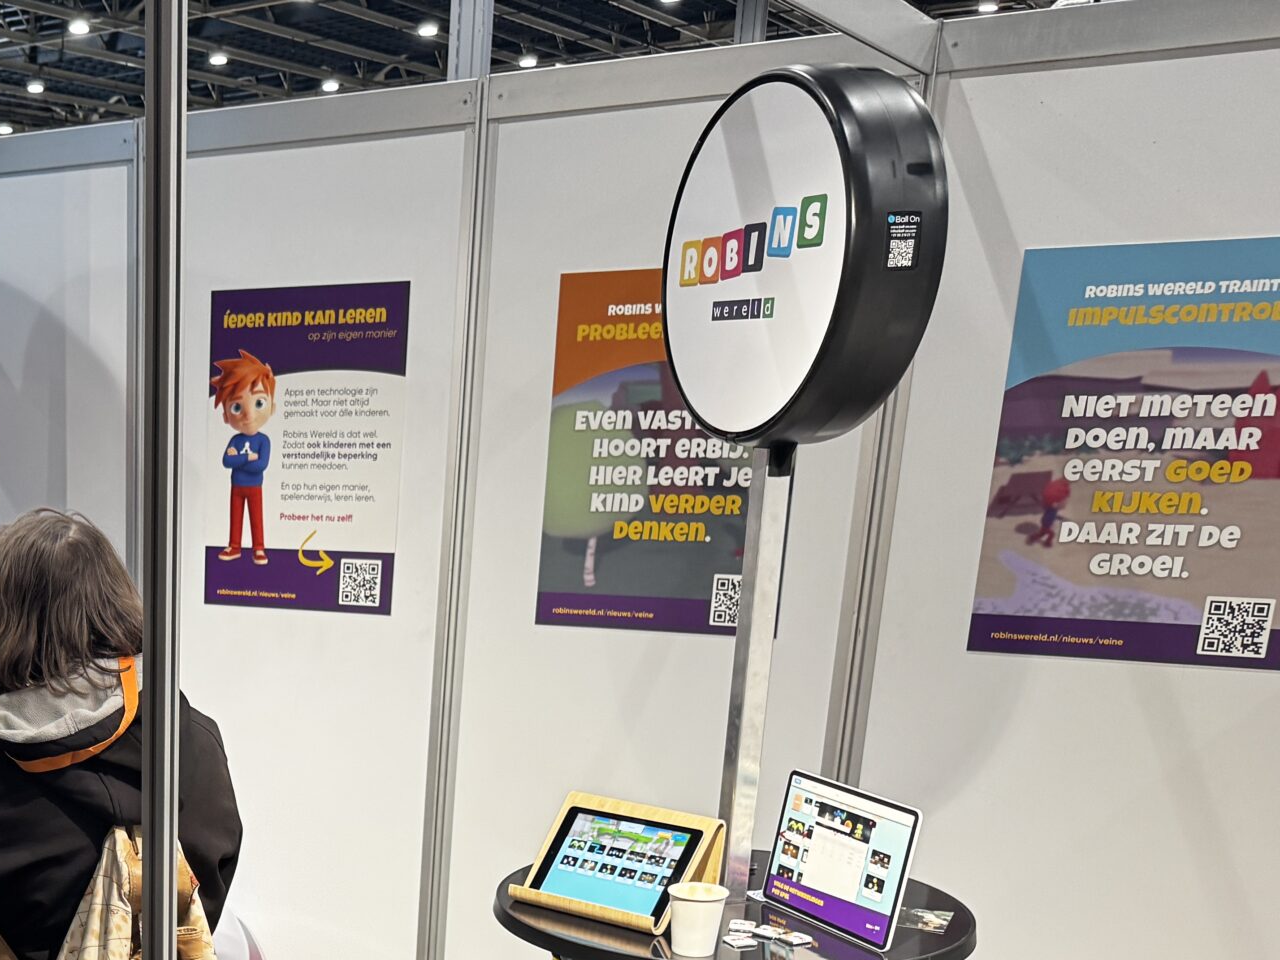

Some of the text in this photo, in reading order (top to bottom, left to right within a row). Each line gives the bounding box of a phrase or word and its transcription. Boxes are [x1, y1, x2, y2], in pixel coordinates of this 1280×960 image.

[910, 215, 920, 223] On
[682, 200, 824, 283] ROBINS
[712, 298, 773, 320] wereld
[308, 327, 397, 342] op zijn eigen manier
[576, 322, 664, 342] PROBLEE
[284, 387, 379, 398] Apps en technologie zijn
[284, 398, 370, 408] overal. Maar niet altijd
[284, 409, 318, 419] gemaakt
[354, 408, 390, 417] kinderen.
[637, 410, 703, 431] VAST
[282, 430, 378, 439] Robins Wereld is dat wel.
[282, 440, 392, 449] Zodat ook kinderen met een
[282, 451, 378, 461] verstandelijke beperking
[281, 462, 348, 470] kunnen meedoen.
[281, 482, 370, 493] En op hun eigen manier,
[280, 493, 333, 503] spelenderwijs,
[334, 493, 353, 501] leren
[279, 512, 353, 523] Probeer het nu zelf!
[990, 631, 1124, 646] robinswereld.nl/nieuws/veine
